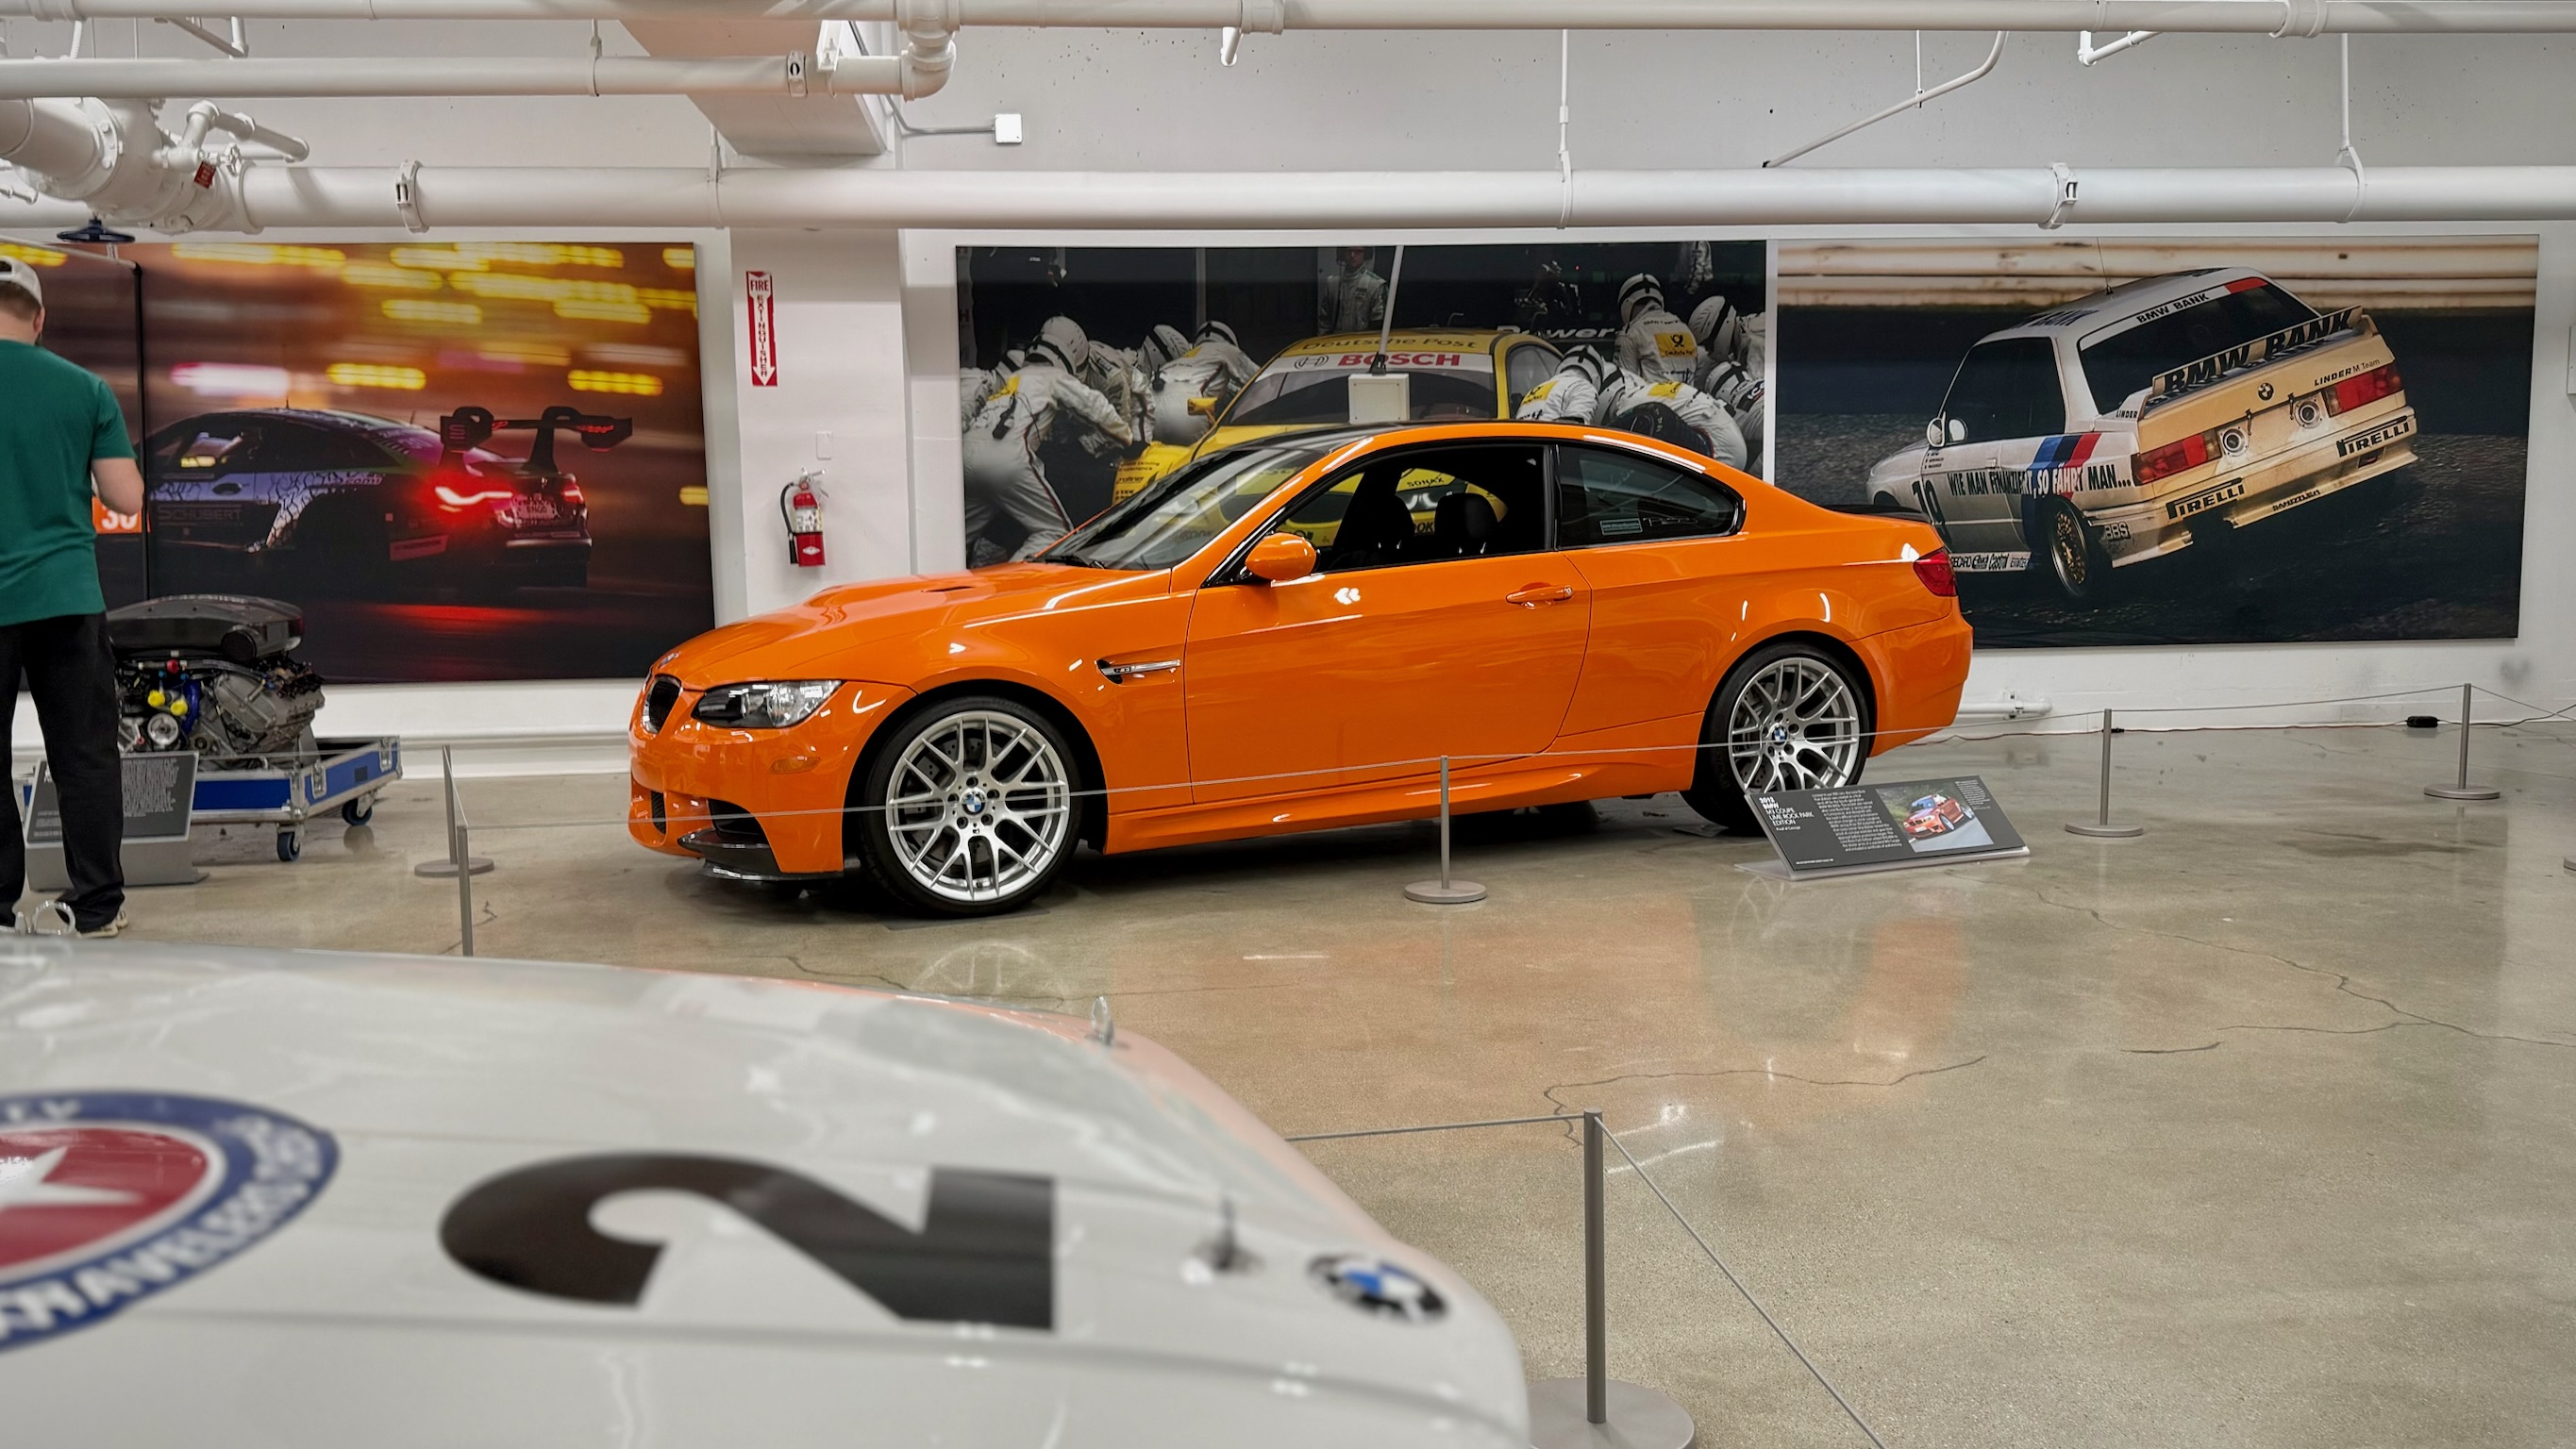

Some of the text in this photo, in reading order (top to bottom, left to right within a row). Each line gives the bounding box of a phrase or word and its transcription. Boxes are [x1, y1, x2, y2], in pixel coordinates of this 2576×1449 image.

[750, 279, 769, 291] FIRE
[2136, 292, 2210, 324] BMW BANK
[757, 294, 767, 377] EXTINGUISHER
[1423, 337, 1478, 349] Post
[1497, 325, 1614, 339] Pwer
[1337, 352, 1461, 367] BOSCH
[2165, 309, 2355, 393] BMW BANK
[2314, 358, 2381, 387] LINDER M Team
[2116, 409, 2138, 419] LINDER
[2335, 415, 2410, 458] PIRELLI
[1407, 475, 1446, 488] SONAX
[1947, 472, 1965, 496] WIE
[1967, 471, 1989, 496] MAN
[2166, 477, 2245, 520] PIRELLI
[2104, 522, 2129, 540] BBS
[438, 1150, 1057, 1334] 2
